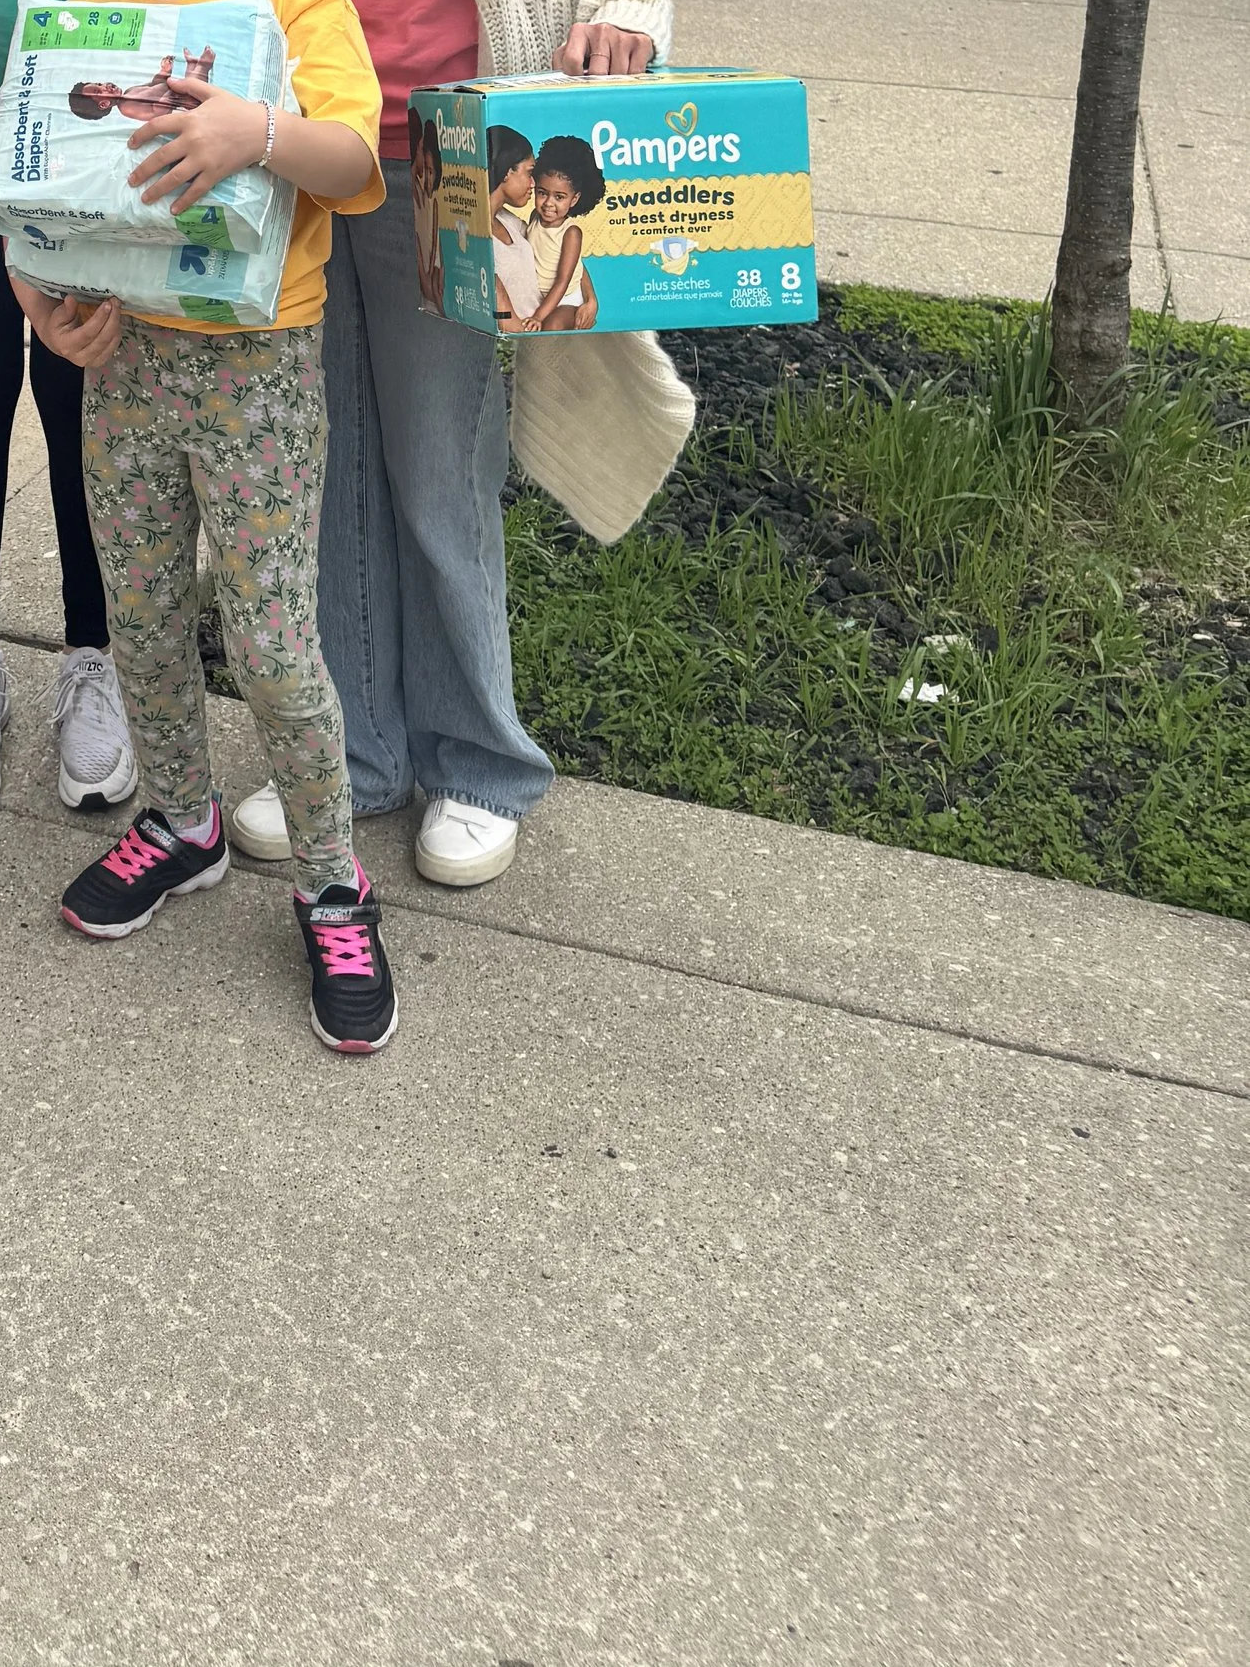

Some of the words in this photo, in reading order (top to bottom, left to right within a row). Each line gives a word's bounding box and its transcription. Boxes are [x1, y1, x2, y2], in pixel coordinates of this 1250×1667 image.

[33, 11, 52, 27] 4
[88, 11, 100, 26] 28
[21, 54, 38, 87] Soft
[18, 90, 31, 98] &
[11, 101, 31, 183] Absorbent
[436, 108, 476, 159] Pampers
[26, 120, 43, 182] Diapers
[591, 120, 741, 172] Pampers
[442, 171, 476, 194] swaddlers
[605, 185, 735, 211] swaddlers
[68, 210, 78, 218] &
[80, 211, 106, 220] Soft
[201, 206, 220, 225] 4
[629, 211, 665, 224] best
[670, 210, 734, 224] dryness
[640, 225, 685, 235] comfort
[687, 225, 712, 233] ever
[481, 267, 488, 299] 8
[736, 269, 762, 286] 38
[781, 262, 801, 290] 8
[643, 278, 669, 294] plus
[671, 277, 711, 289] sèches
[733, 287, 768, 298] DIAPERS
[684, 293, 698, 301] que
[730, 296, 772, 309] COUCHES
